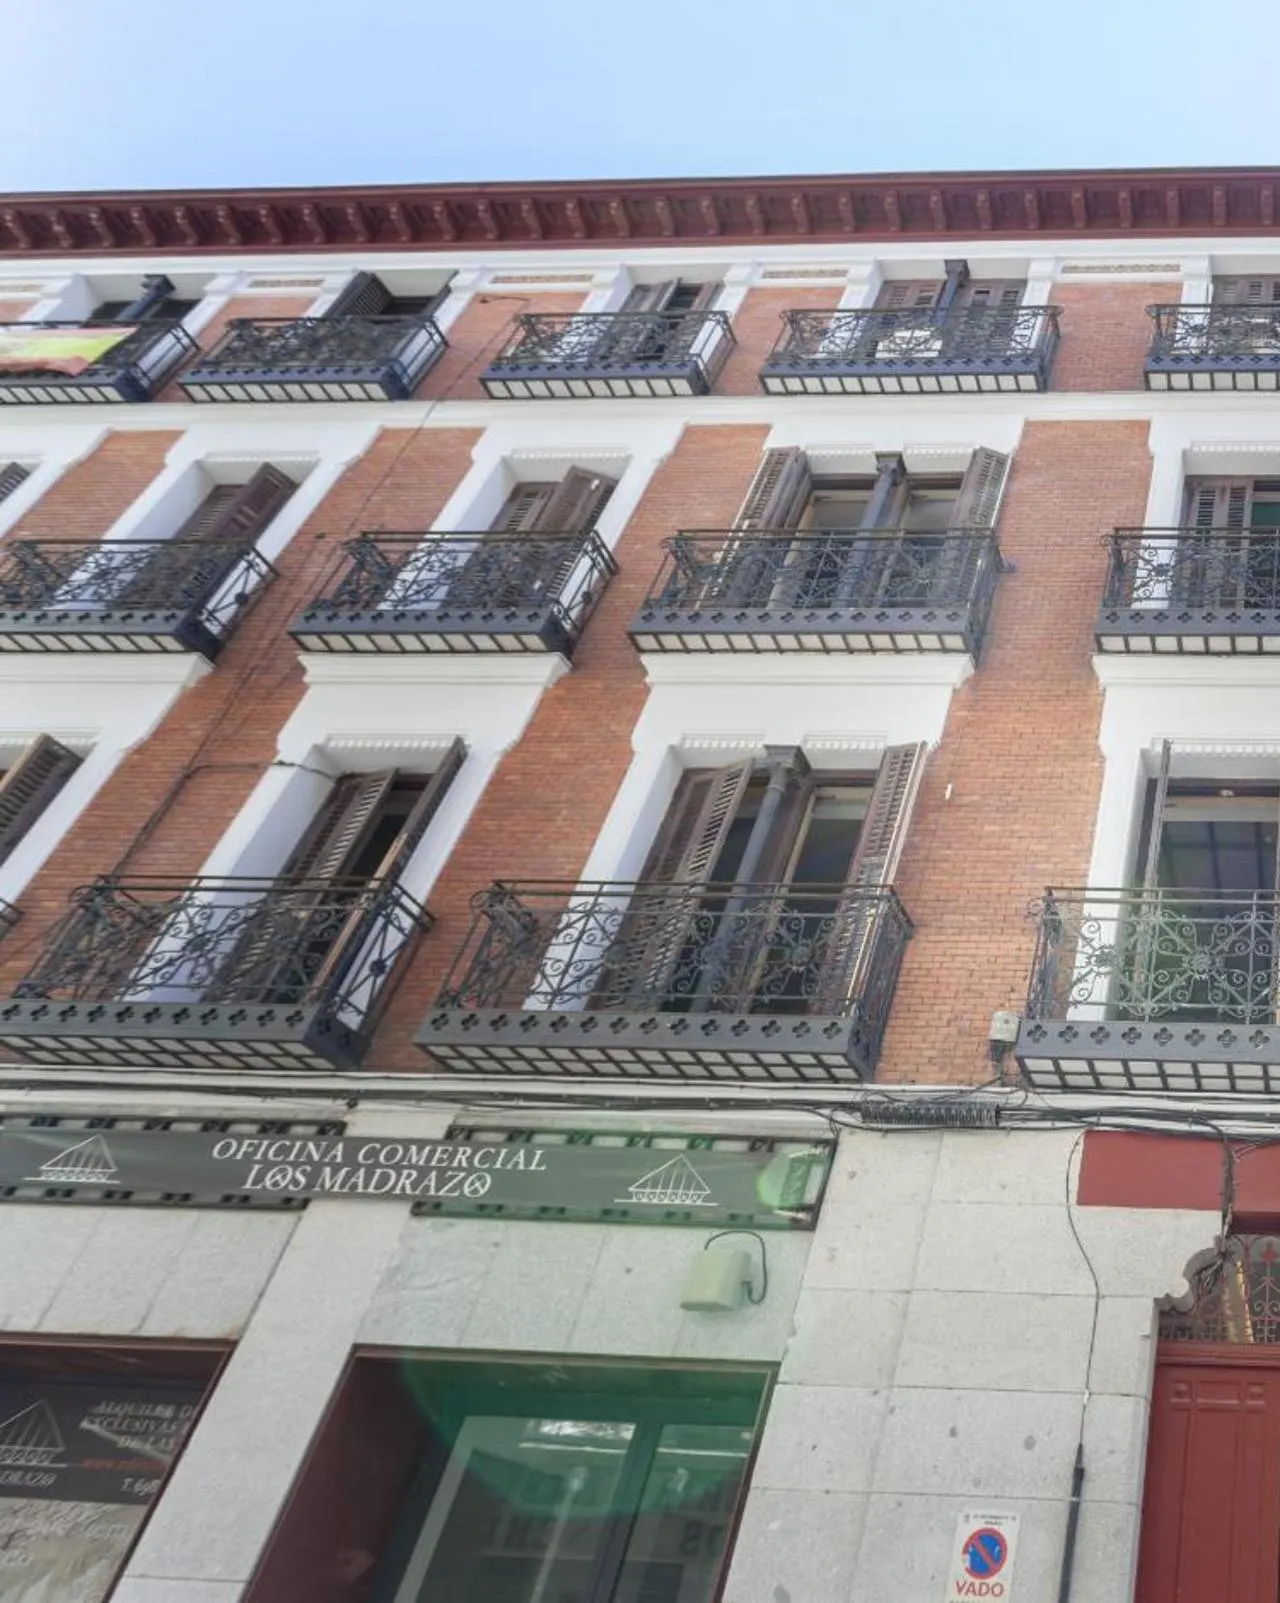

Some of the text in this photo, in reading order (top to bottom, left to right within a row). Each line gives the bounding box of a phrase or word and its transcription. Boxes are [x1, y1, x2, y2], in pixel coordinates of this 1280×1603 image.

[211, 1137, 547, 1172] OFICINA COMERCIAL
[241, 1163, 492, 1197] LOS MADRAZO
[956, 1580, 1005, 1598] VADO
